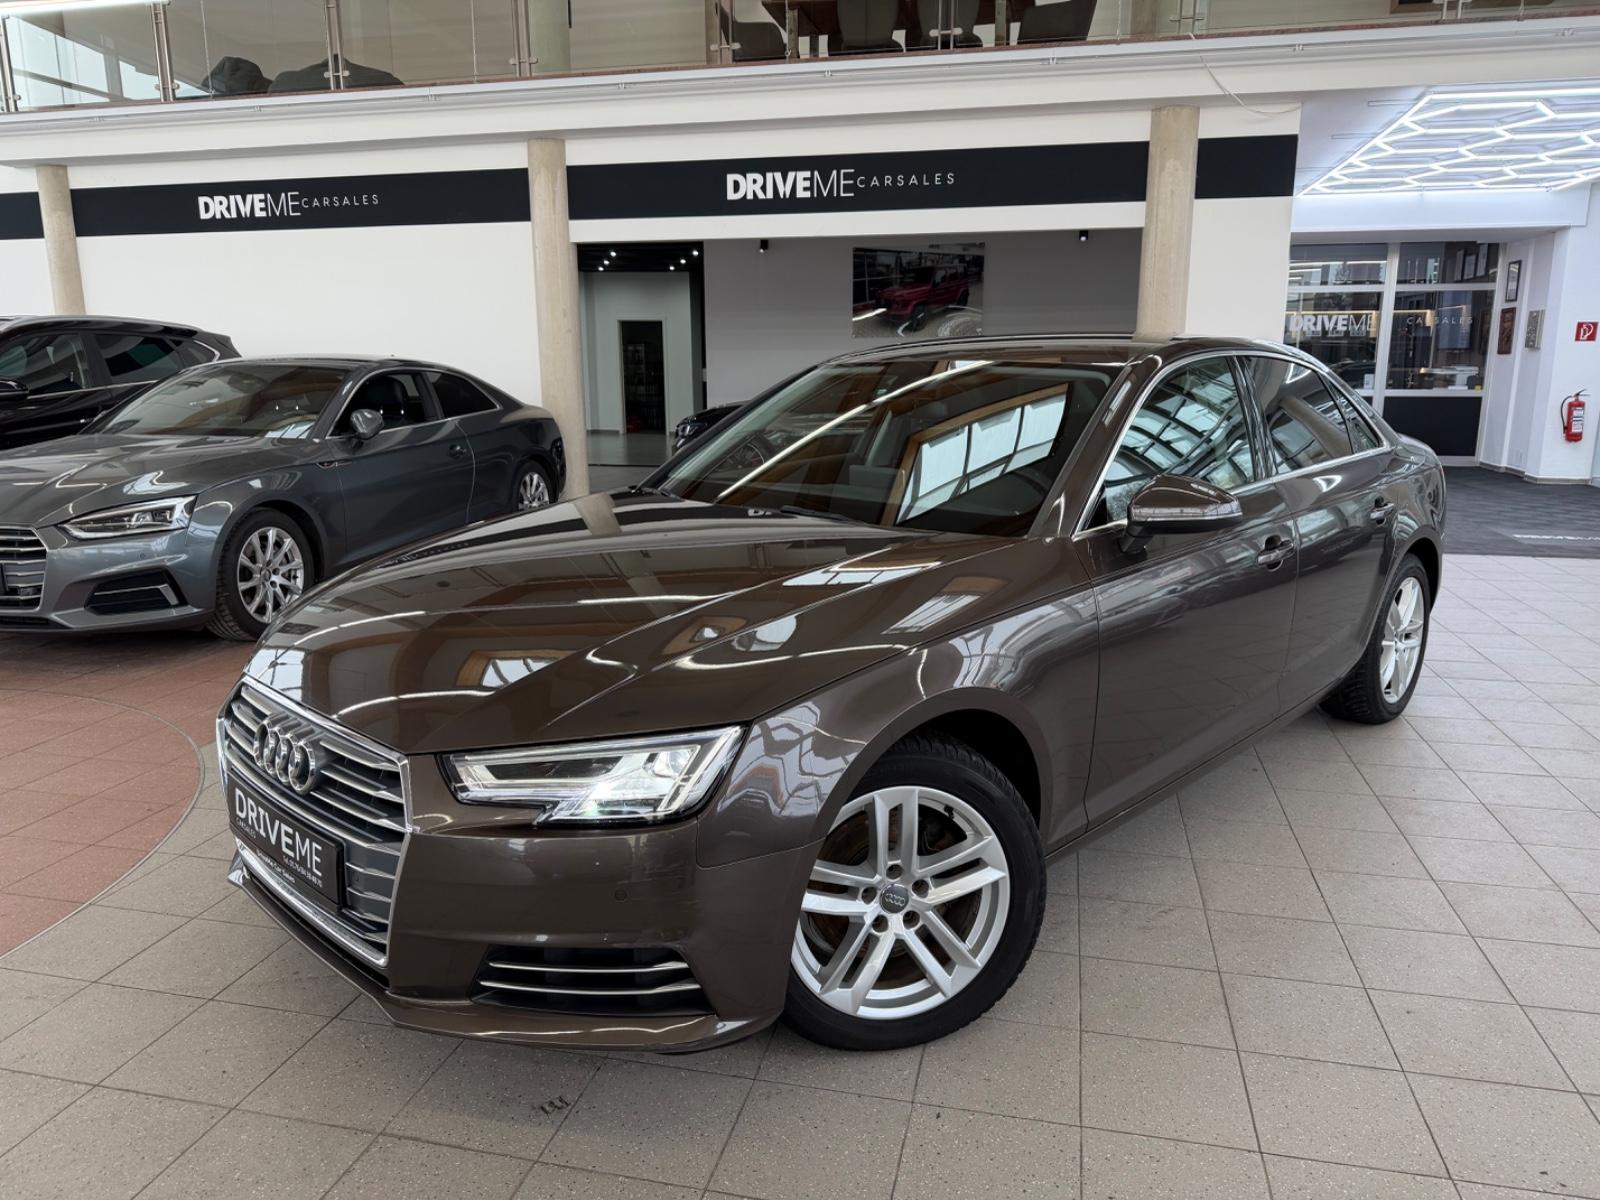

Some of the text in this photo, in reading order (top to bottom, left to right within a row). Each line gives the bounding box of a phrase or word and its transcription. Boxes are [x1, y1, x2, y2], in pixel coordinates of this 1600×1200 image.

[726, 168, 955, 201] DRIVEME CARSALES
[197, 191, 380, 220] DRIVEME CARSALES
[1406, 316, 1473, 326] CASALES
[234, 787, 322, 877] DRIVEME
